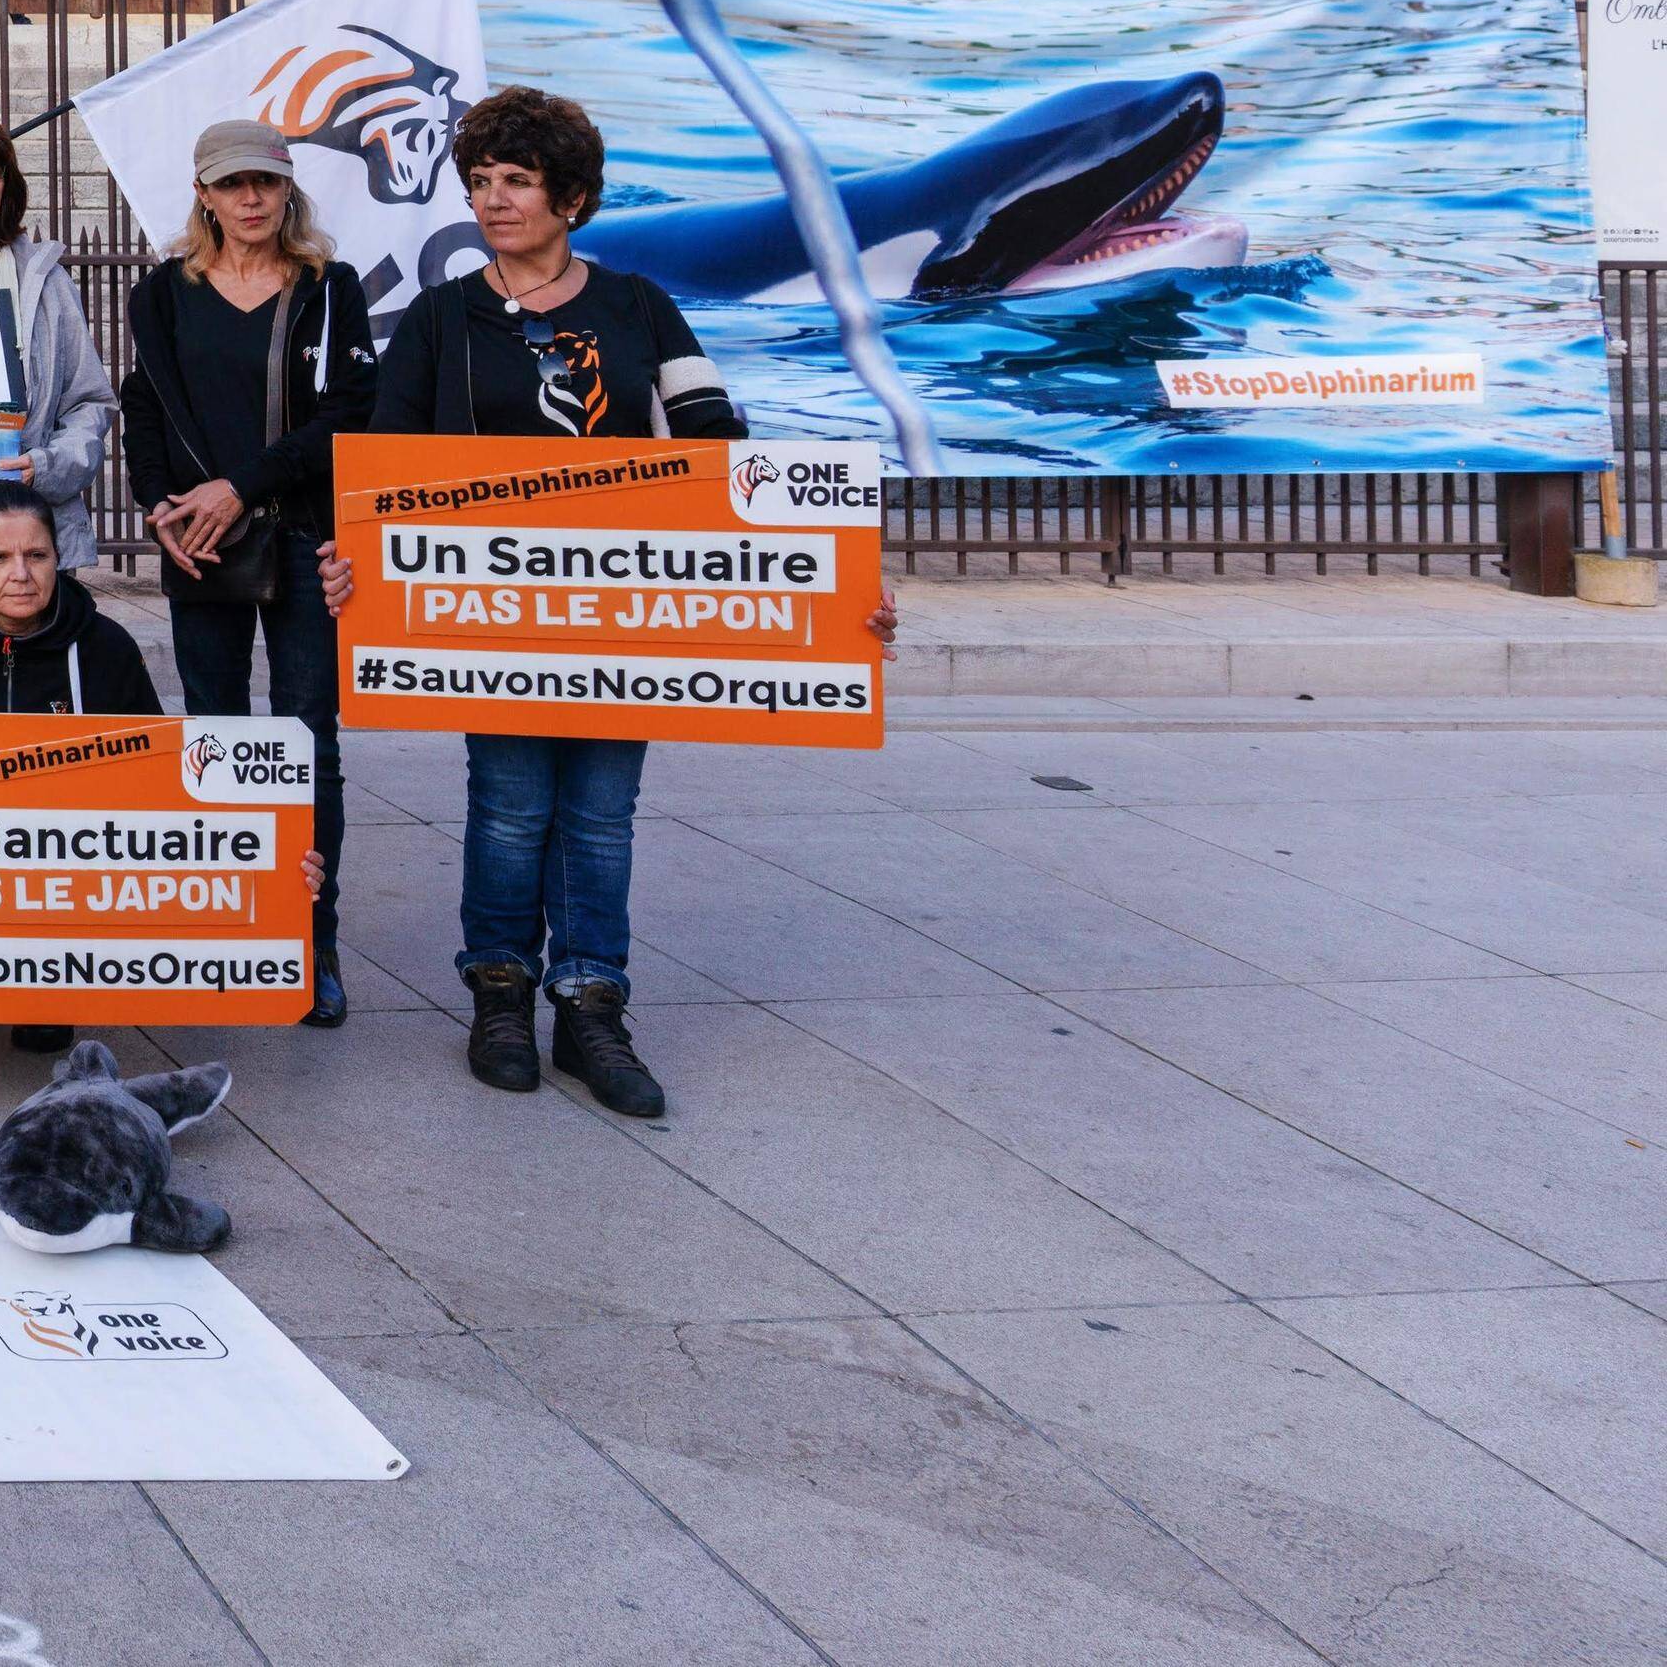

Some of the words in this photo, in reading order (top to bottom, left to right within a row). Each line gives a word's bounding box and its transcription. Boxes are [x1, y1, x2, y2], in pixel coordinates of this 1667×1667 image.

[1172, 368, 1477, 402] #StopDelphinarium
[375, 453, 690, 514] #StopDelphinarium
[786, 463, 848, 485] ONE
[786, 485, 878, 508] VOICE
[391, 534, 466, 574] Un
[487, 535, 818, 584] Sanctuaire
[424, 588, 521, 625] PAS
[535, 592, 601, 627] LE
[615, 594, 794, 631] JAPON
[357, 658, 867, 713] #SauvonsNosOrques
[232, 741, 286, 762] ONE
[232, 764, 310, 785] VOICE
[15, 875, 72, 911] LE
[86, 875, 242, 911] JAPON
[98, 1312, 162, 1331] one
[115, 1330, 208, 1353] voice
